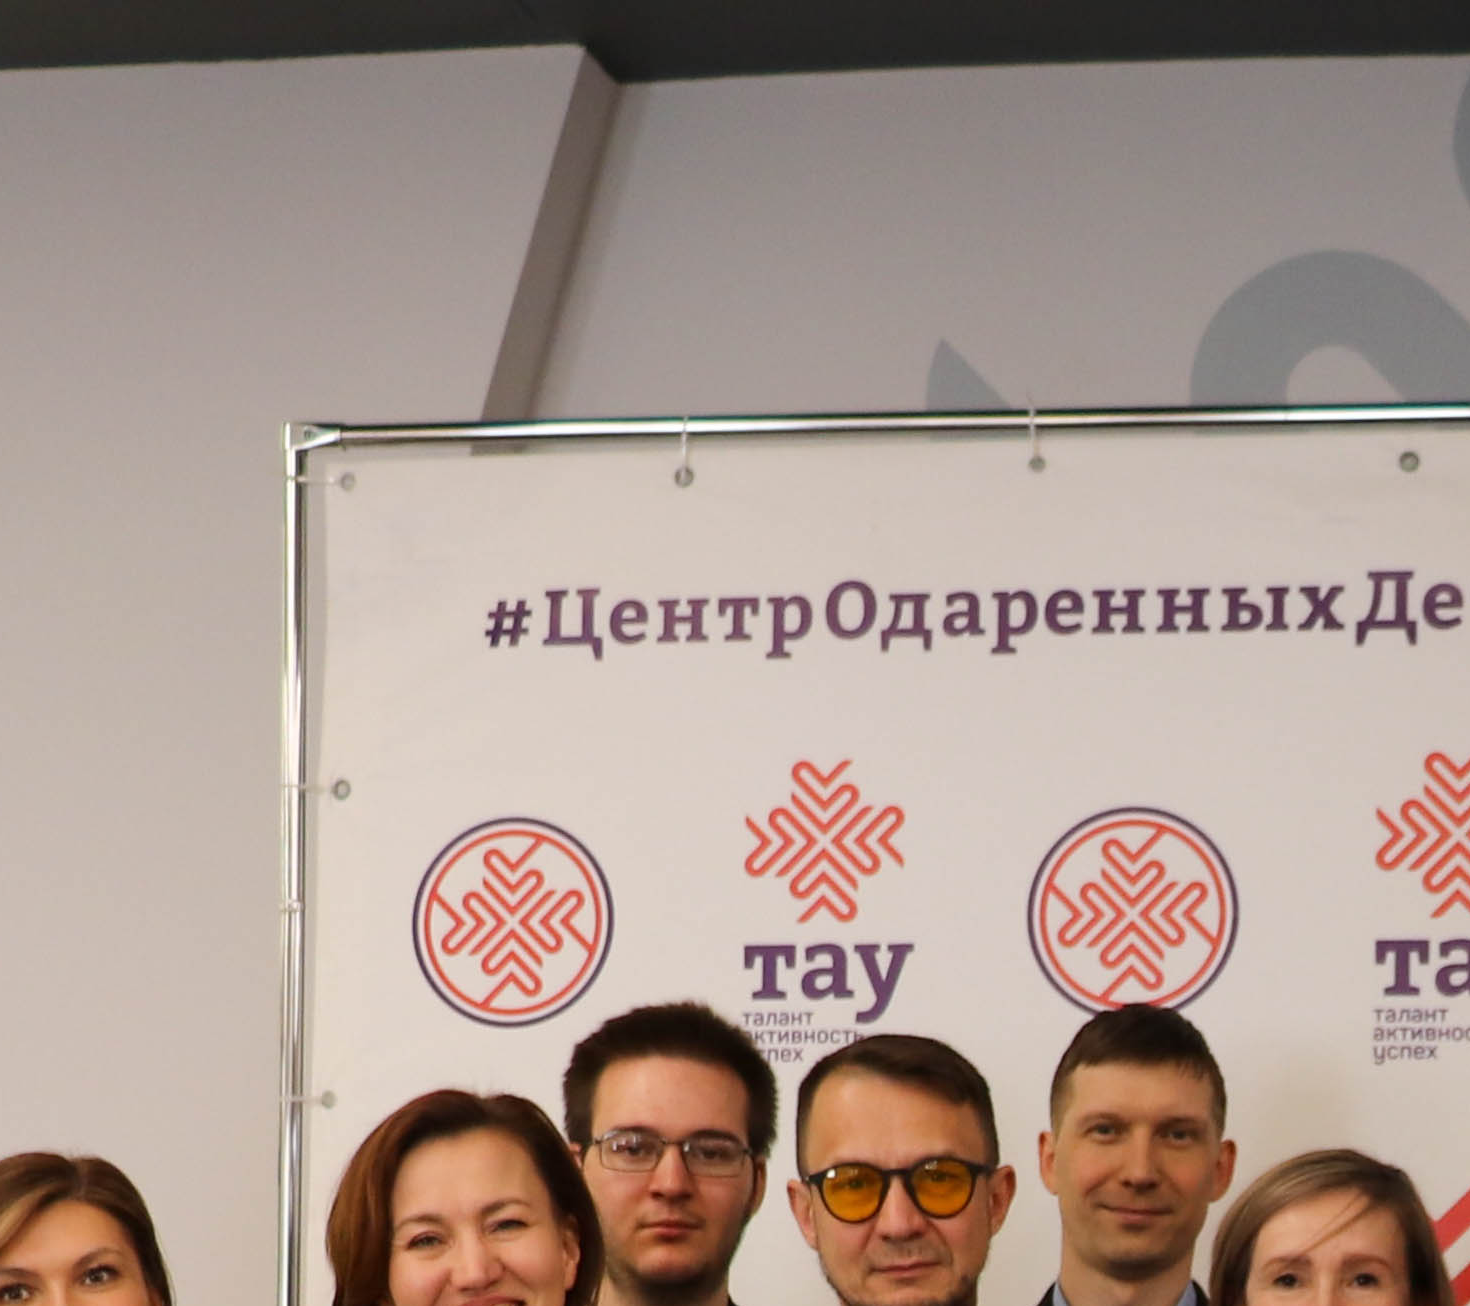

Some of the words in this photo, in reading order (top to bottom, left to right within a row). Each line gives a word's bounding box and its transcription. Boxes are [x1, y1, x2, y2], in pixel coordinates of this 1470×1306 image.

[742, 942, 915, 1025] тау
[741, 1011, 815, 1027] талант
[1373, 1007, 1449, 1024] талант
[746, 1029, 866, 1045] ктивность
[1372, 1044, 1438, 1066] успех
